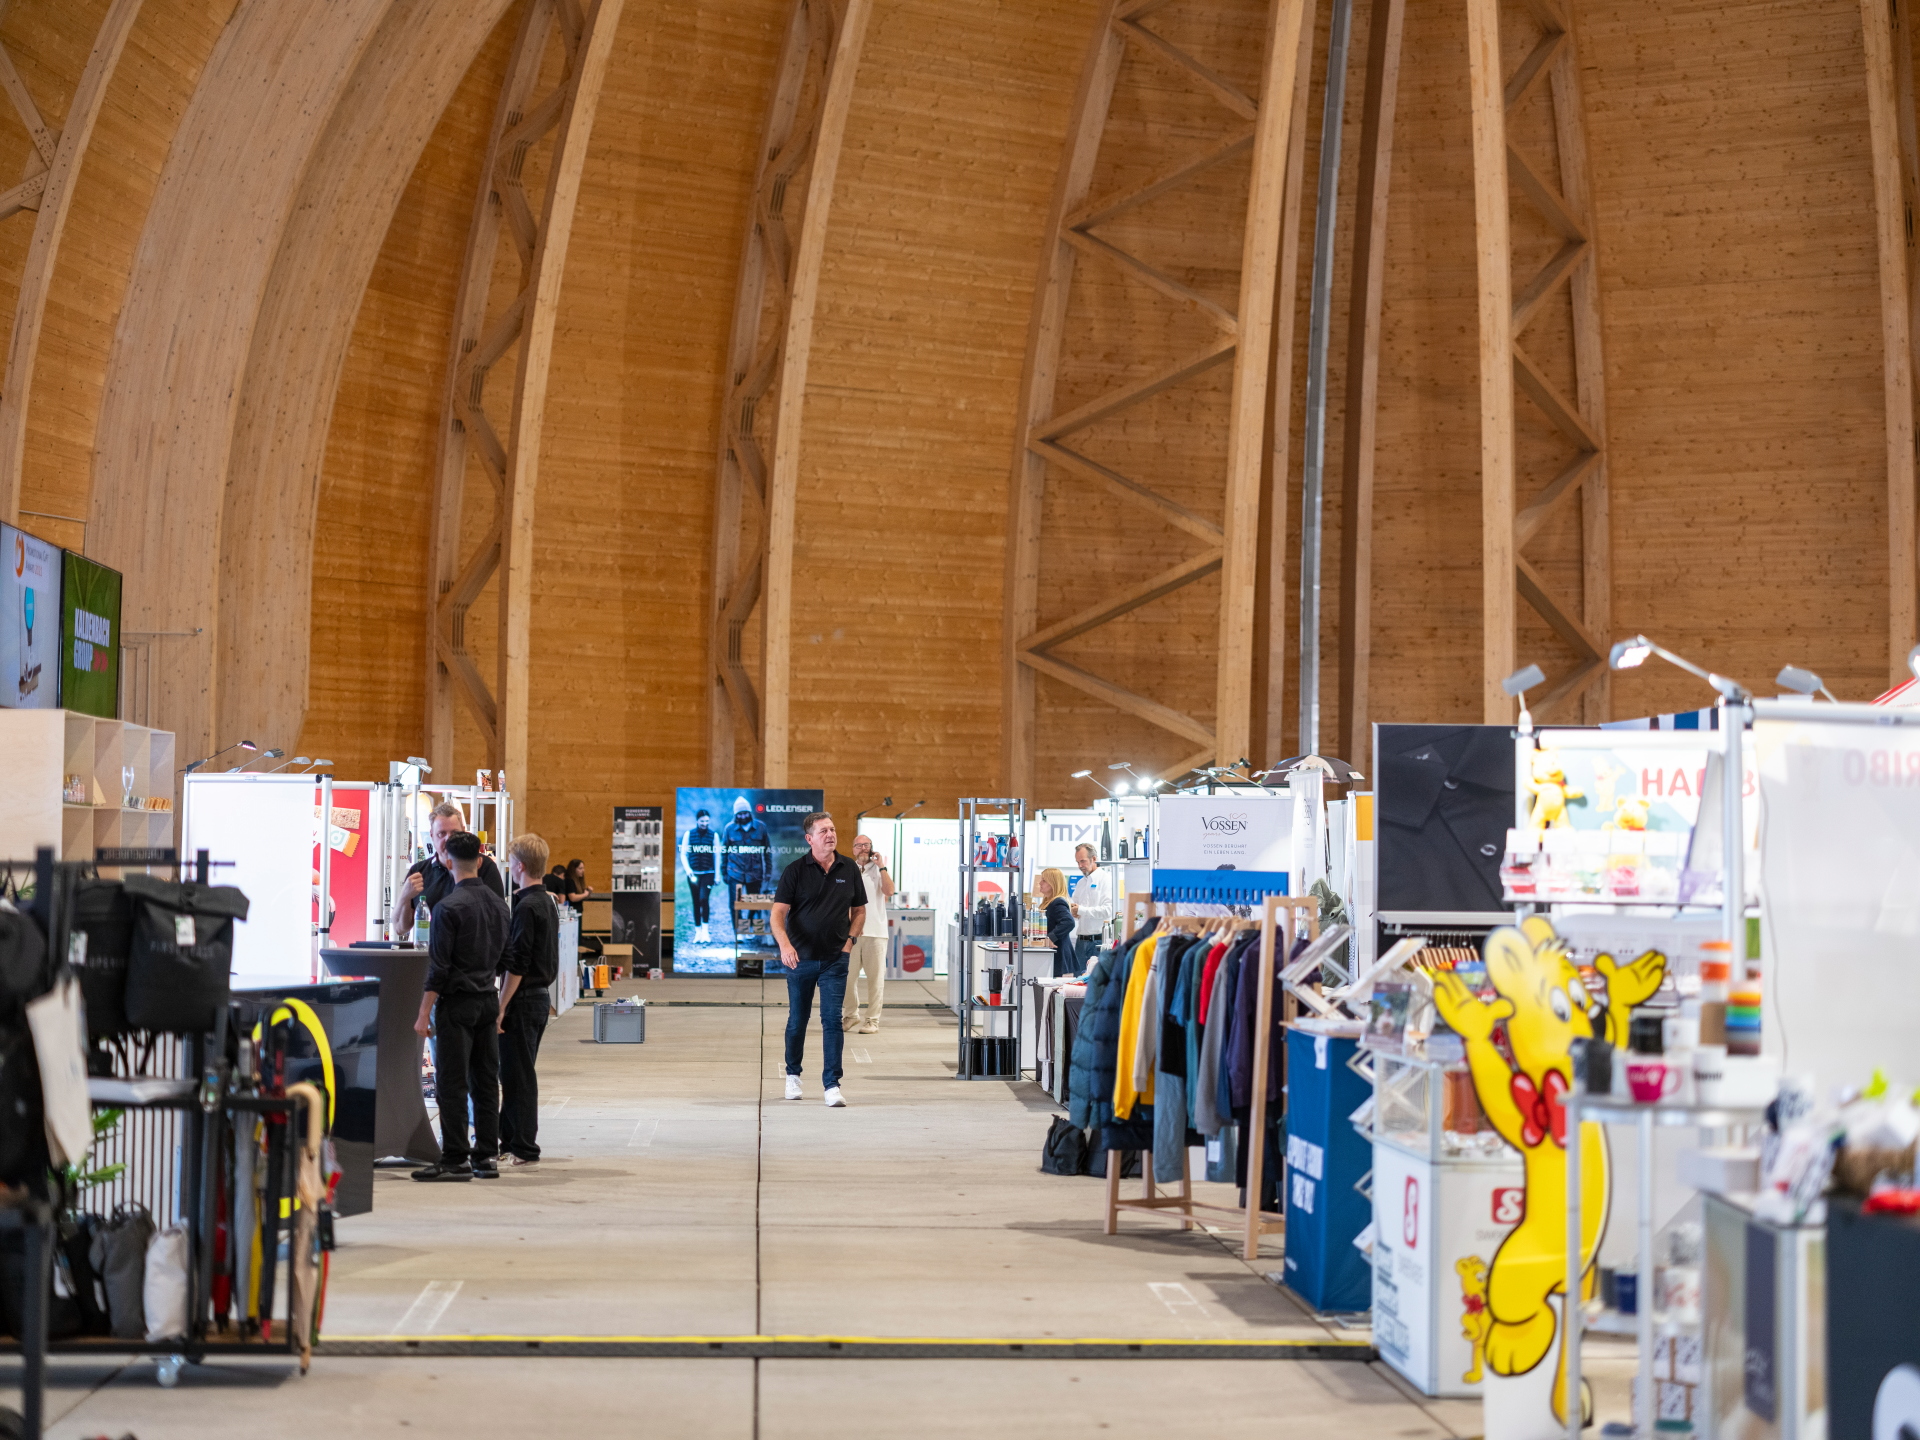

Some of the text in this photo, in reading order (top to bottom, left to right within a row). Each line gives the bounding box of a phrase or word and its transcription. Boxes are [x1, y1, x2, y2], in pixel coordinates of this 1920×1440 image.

[74, 608, 110, 648] KALDENBACH
[73, 638, 94, 672] GROUP
[765, 804, 813, 813] LEDLENSER
[1201, 816, 1247, 831] VOSSEN
[678, 844, 692, 853] THE
[692, 844, 718, 853] WORLD
[719, 844, 727, 853] IS
[727, 844, 738, 853] AS
[738, 844, 765, 854] BRIGHT
[765, 844, 776, 854] AS
[776, 845, 792, 854] YOU
